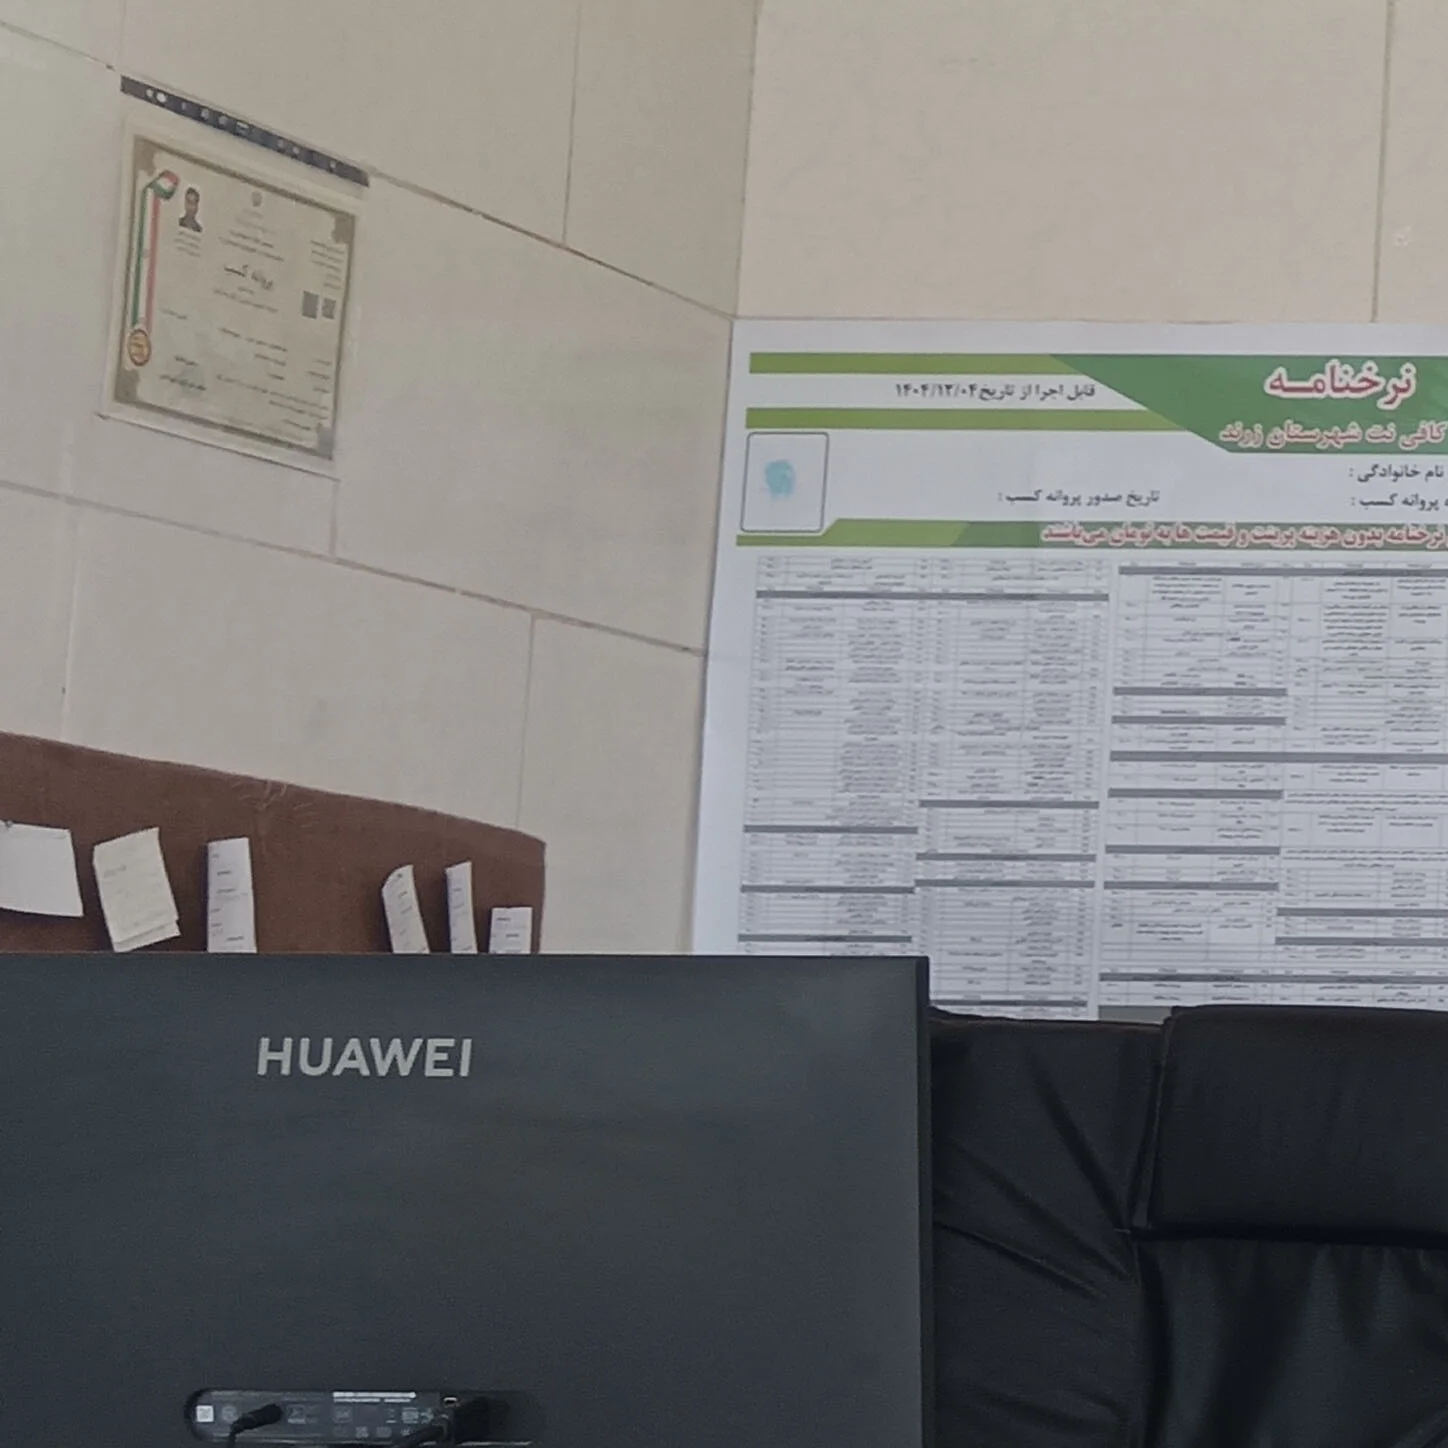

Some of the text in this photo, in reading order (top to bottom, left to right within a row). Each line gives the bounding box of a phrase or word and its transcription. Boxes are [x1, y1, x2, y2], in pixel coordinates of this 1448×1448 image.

[979, 383, 1016, 401] تاریخ
[1019, 384, 1033, 401] از
[1035, 383, 1063, 401] اجرا
[1067, 383, 1096, 401] قابل
[1264, 359, 1417, 409] نرخنامه
[1219, 420, 1263, 448] زرند
[1265, 419, 1362, 449] شهرستان
[1364, 421, 1396, 444] نت
[1357, 464, 1421, 483] خانوادگی
[1424, 465, 1445, 482] نام
[1005, 489, 1042, 505] کسب
[1045, 489, 1082, 506] پروانه
[1086, 493, 1122, 507] صدور
[1126, 490, 1160, 507] تاریخ
[1359, 493, 1398, 509] کسب
[1402, 494, 1439, 511] پروانه
[1236, 529, 1249, 548] و
[1250, 524, 1297, 548] پرینت
[1298, 525, 1340, 548] هزینه
[1340, 525, 1384, 548] بدون
[1384, 520, 1445, 549] نرخنامه
[257, 1037, 473, 1078] HUAWEI
